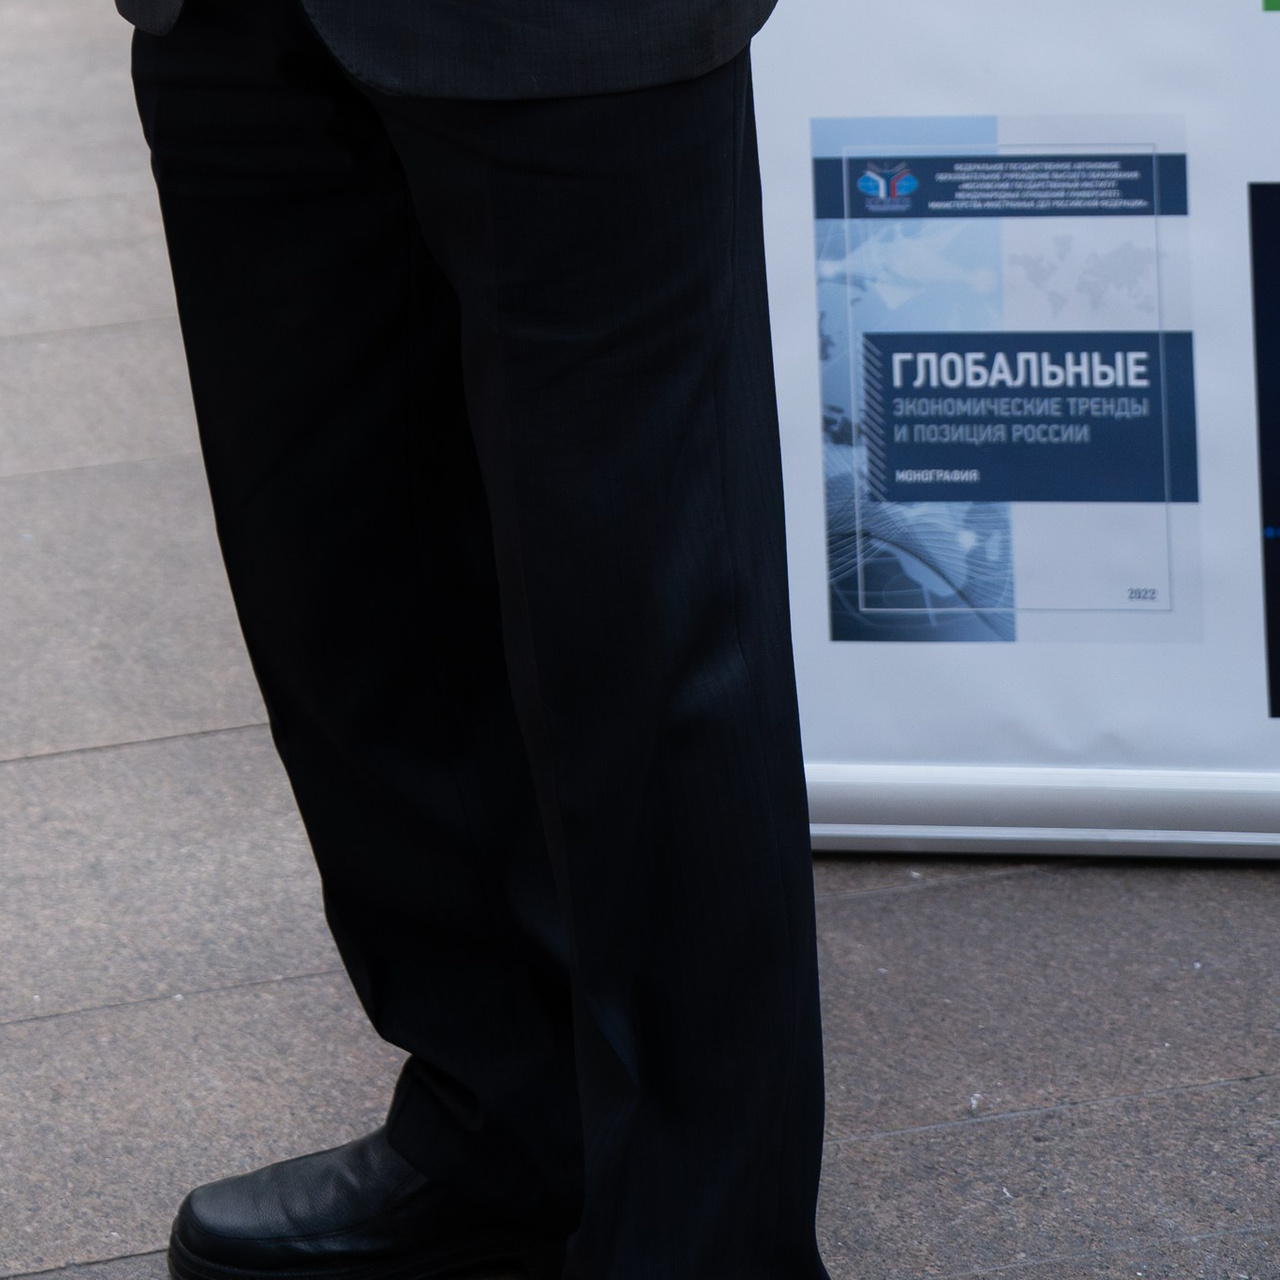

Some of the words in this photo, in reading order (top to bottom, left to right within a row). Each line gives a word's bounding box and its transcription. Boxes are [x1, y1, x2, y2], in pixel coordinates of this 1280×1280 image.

[892, 351, 1150, 389] ГЛОБАЛЬНЫЕ
[893, 397, 1064, 418] ЭКОНОМИЧЕСКИЕ
[1066, 397, 1150, 420] ТРЕНДЫ
[894, 423, 908, 443] И
[913, 423, 1006, 446] ПОЗИЦИЯ
[1011, 423, 1090, 444] РОССИИ
[895, 468, 980, 483] МОНОГРАФИЯ
